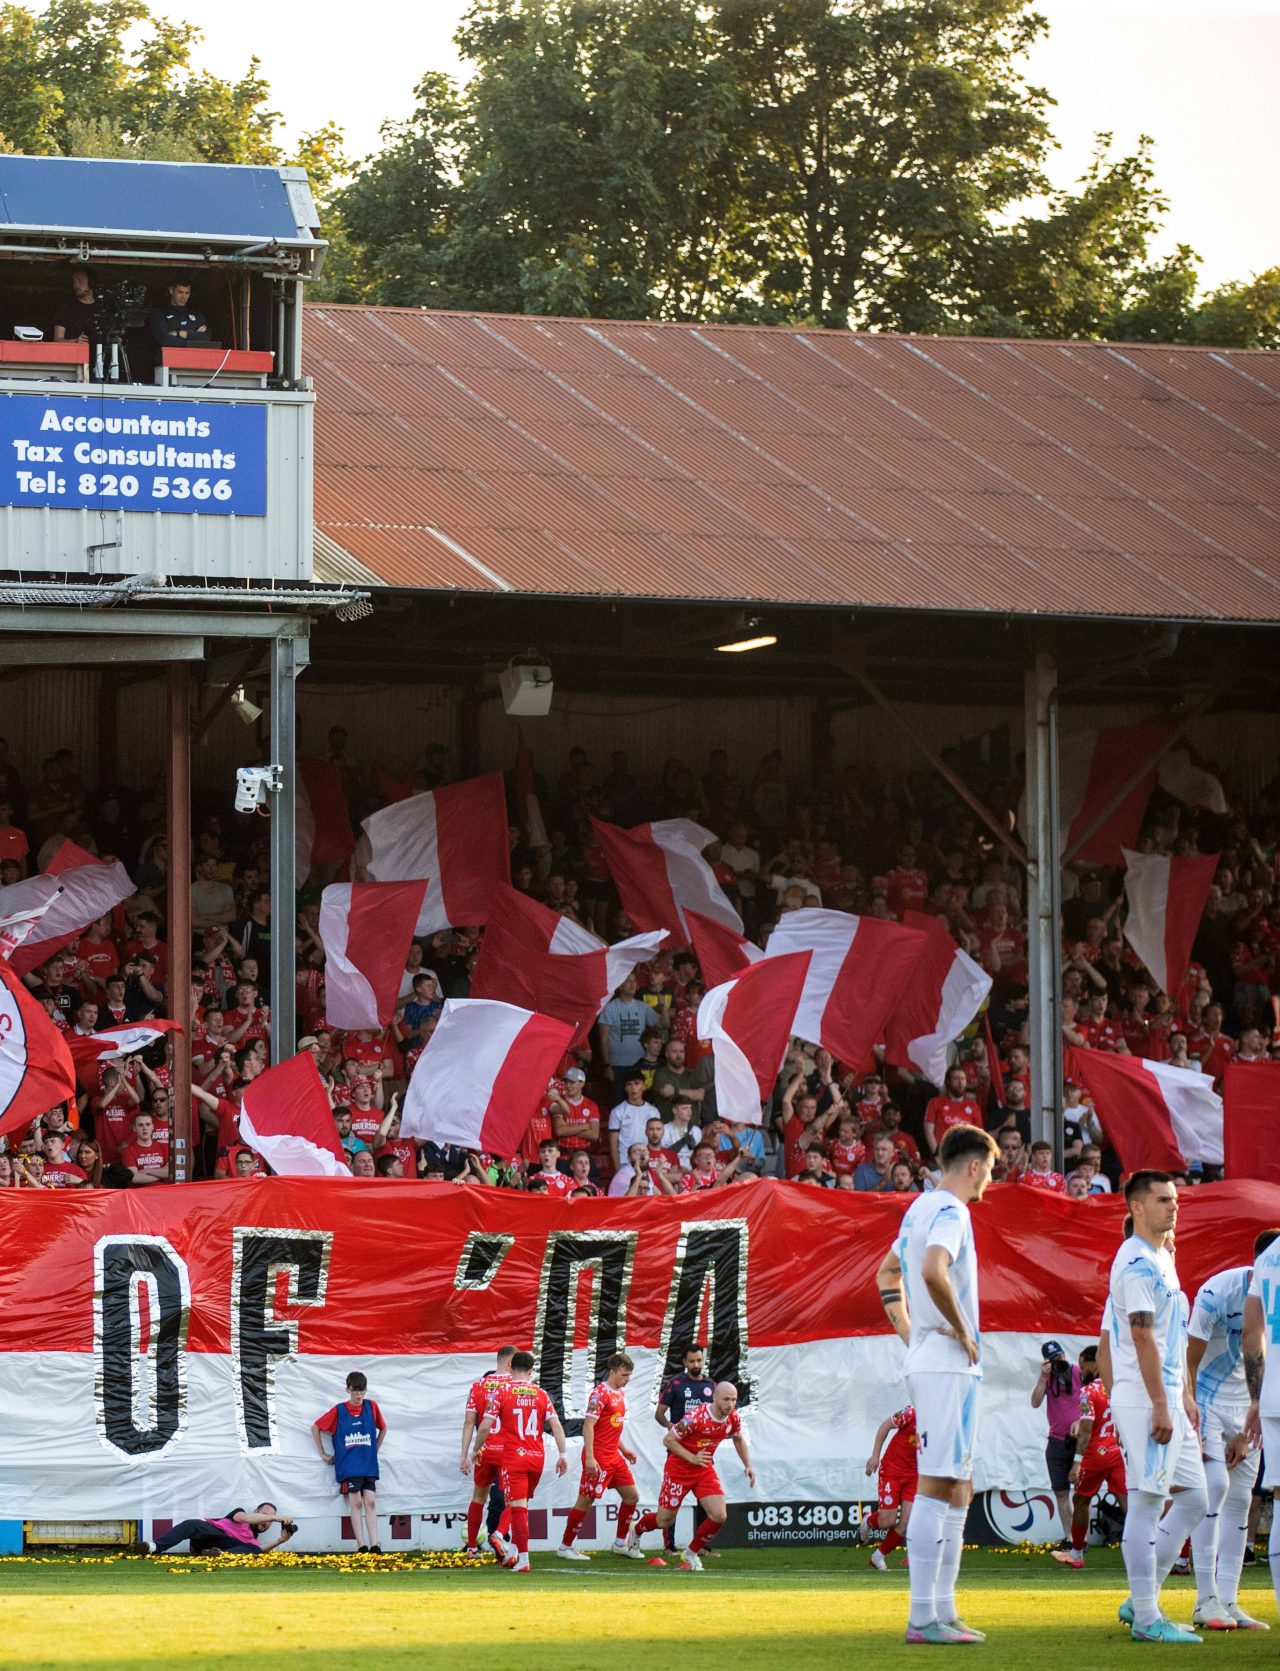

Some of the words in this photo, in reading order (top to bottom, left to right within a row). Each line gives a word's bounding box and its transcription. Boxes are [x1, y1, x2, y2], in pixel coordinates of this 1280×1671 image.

[39, 409, 211, 438] Accountants
[12, 439, 64, 463] Tax
[73, 442, 237, 470] Consultants
[16, 470, 67, 495] Tel:
[77, 473, 140, 498] 820
[150, 476, 233, 501] 5366
[93, 1226, 335, 1463] OF
[512, 1408, 539, 1441] 14
[669, 1482, 683, 1496] 23
[747, 1505, 794, 1527] 083
[797, 1505, 844, 1526] 380
